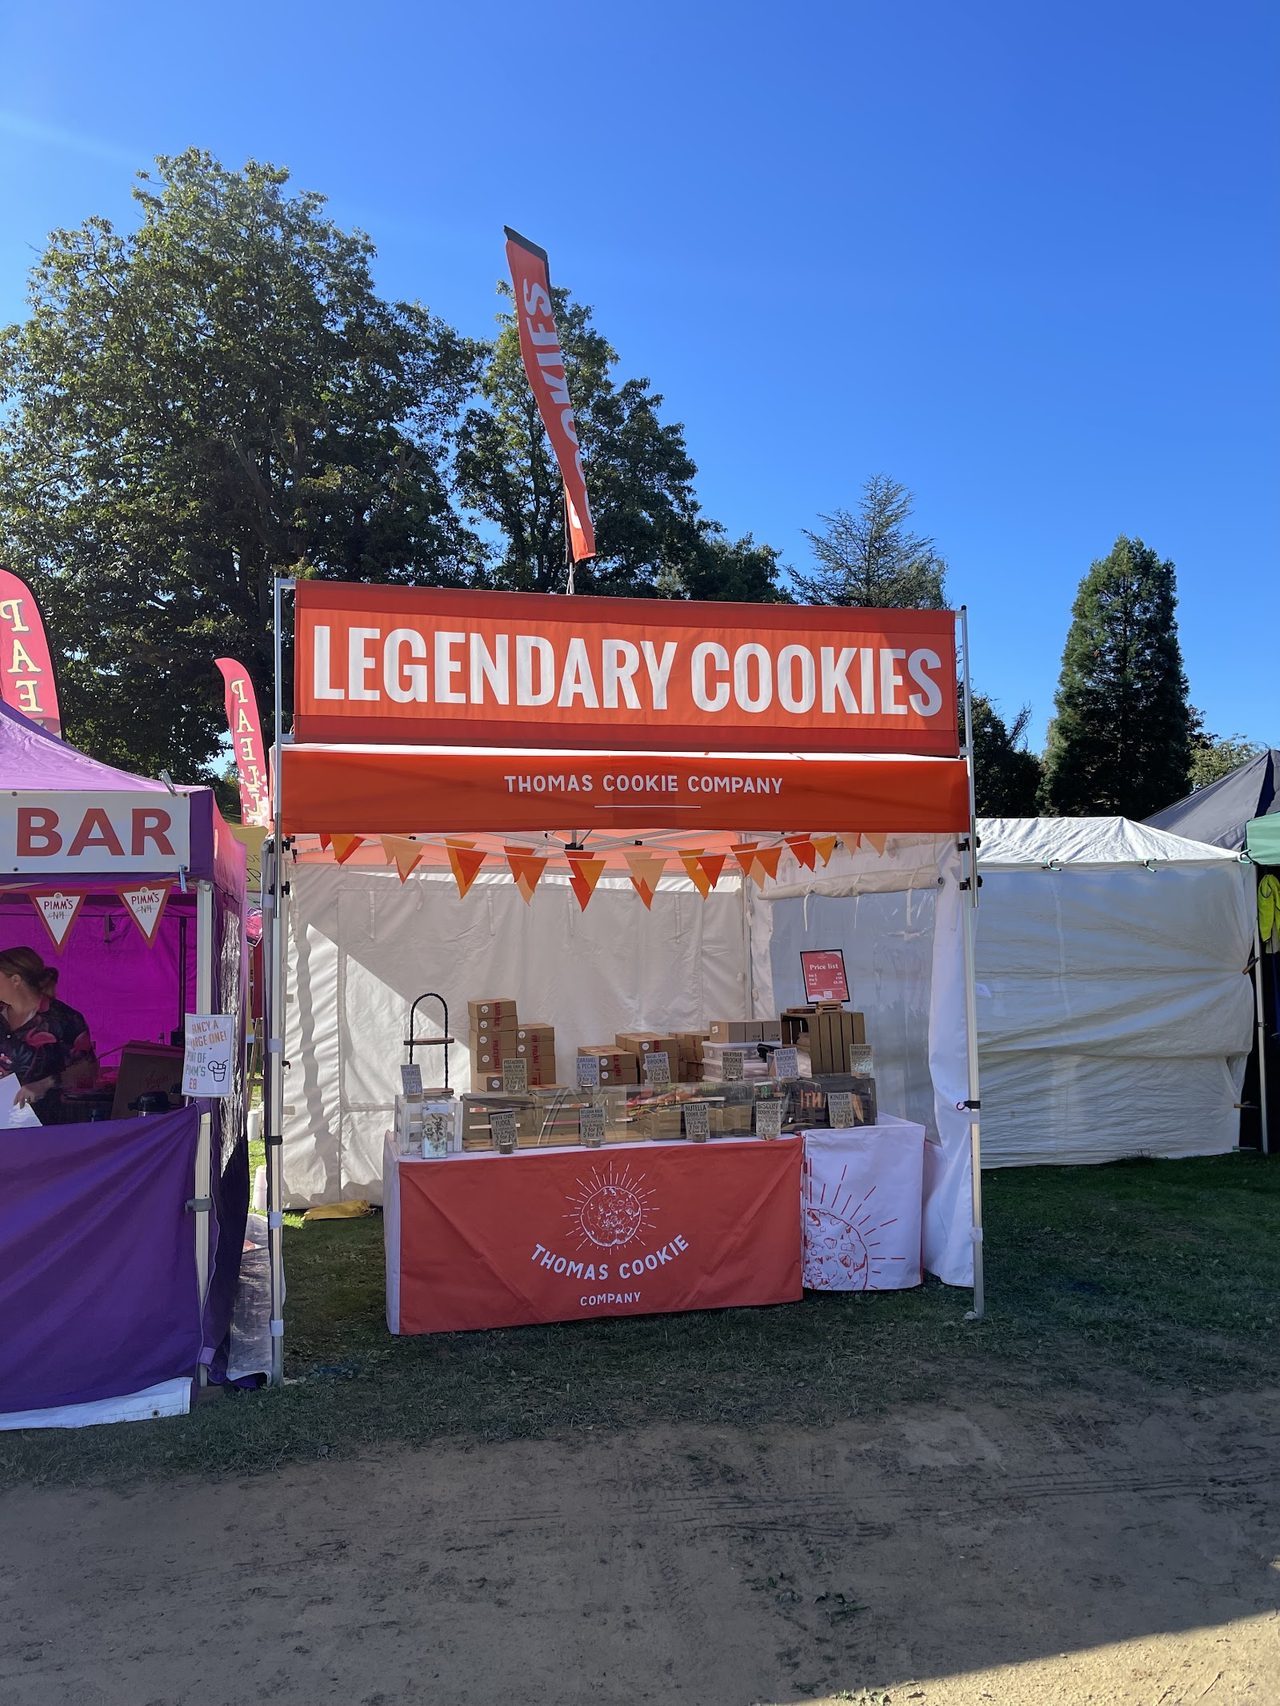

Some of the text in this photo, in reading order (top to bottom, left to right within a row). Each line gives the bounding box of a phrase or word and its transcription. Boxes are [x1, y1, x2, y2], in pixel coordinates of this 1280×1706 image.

[313, 624, 943, 718] LEGENDARY COOKIES
[504, 774, 783, 795] THOMAS COOKIE COMPANY
[16, 807, 176, 857] BAR
[43, 898, 74, 911] PIMM'S
[131, 892, 160, 905] PIMM'S
[213, 1019, 219, 1030] A
[197, 1052, 207, 1063] OF
[685, 1104, 707, 1112] NUTELLA
[531, 1234, 689, 1281] THOMAS COOKIE
[580, 1291, 642, 1307] COMPANY
